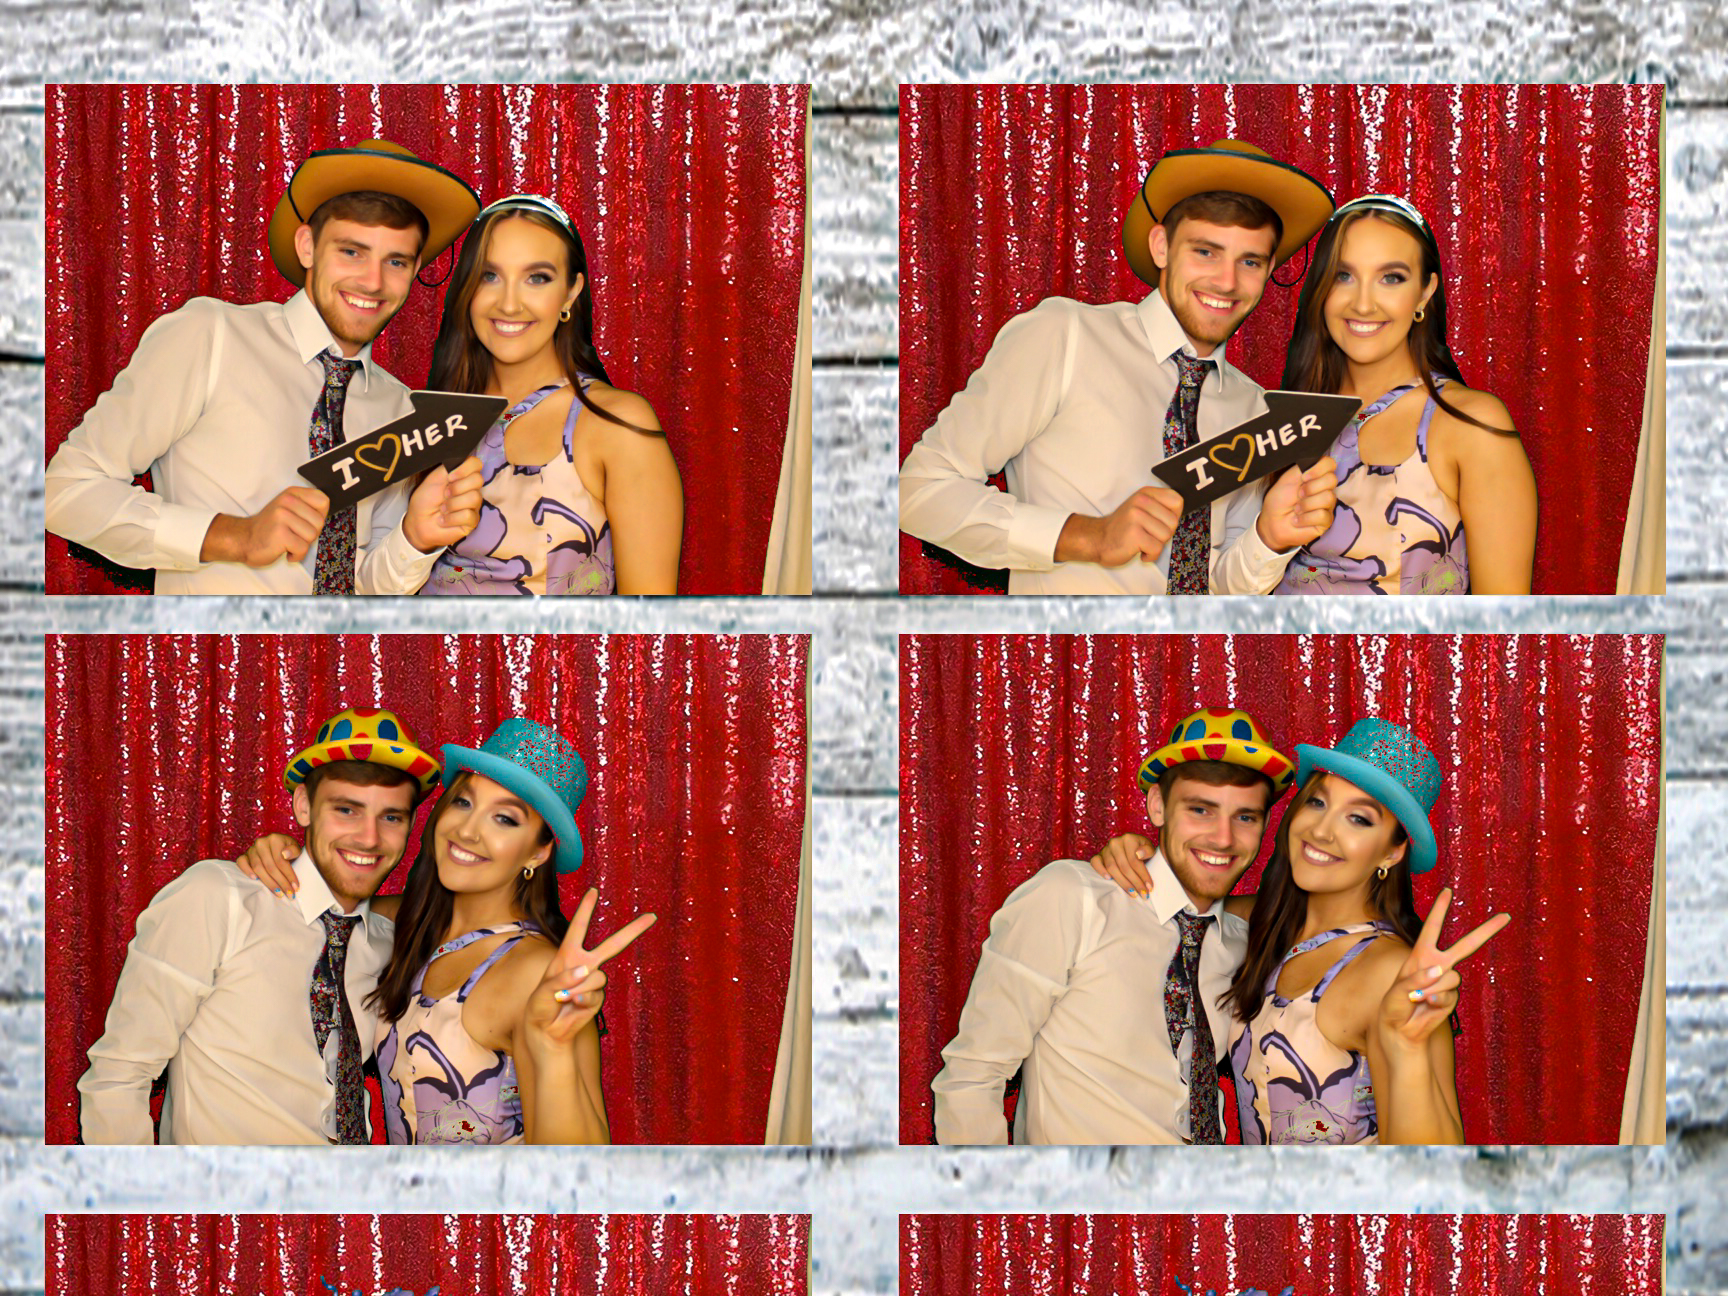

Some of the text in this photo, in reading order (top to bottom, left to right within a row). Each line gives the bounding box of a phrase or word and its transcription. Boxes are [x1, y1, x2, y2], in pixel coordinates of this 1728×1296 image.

[331, 414, 468, 491] I HER
[1185, 414, 1322, 491] I HER
